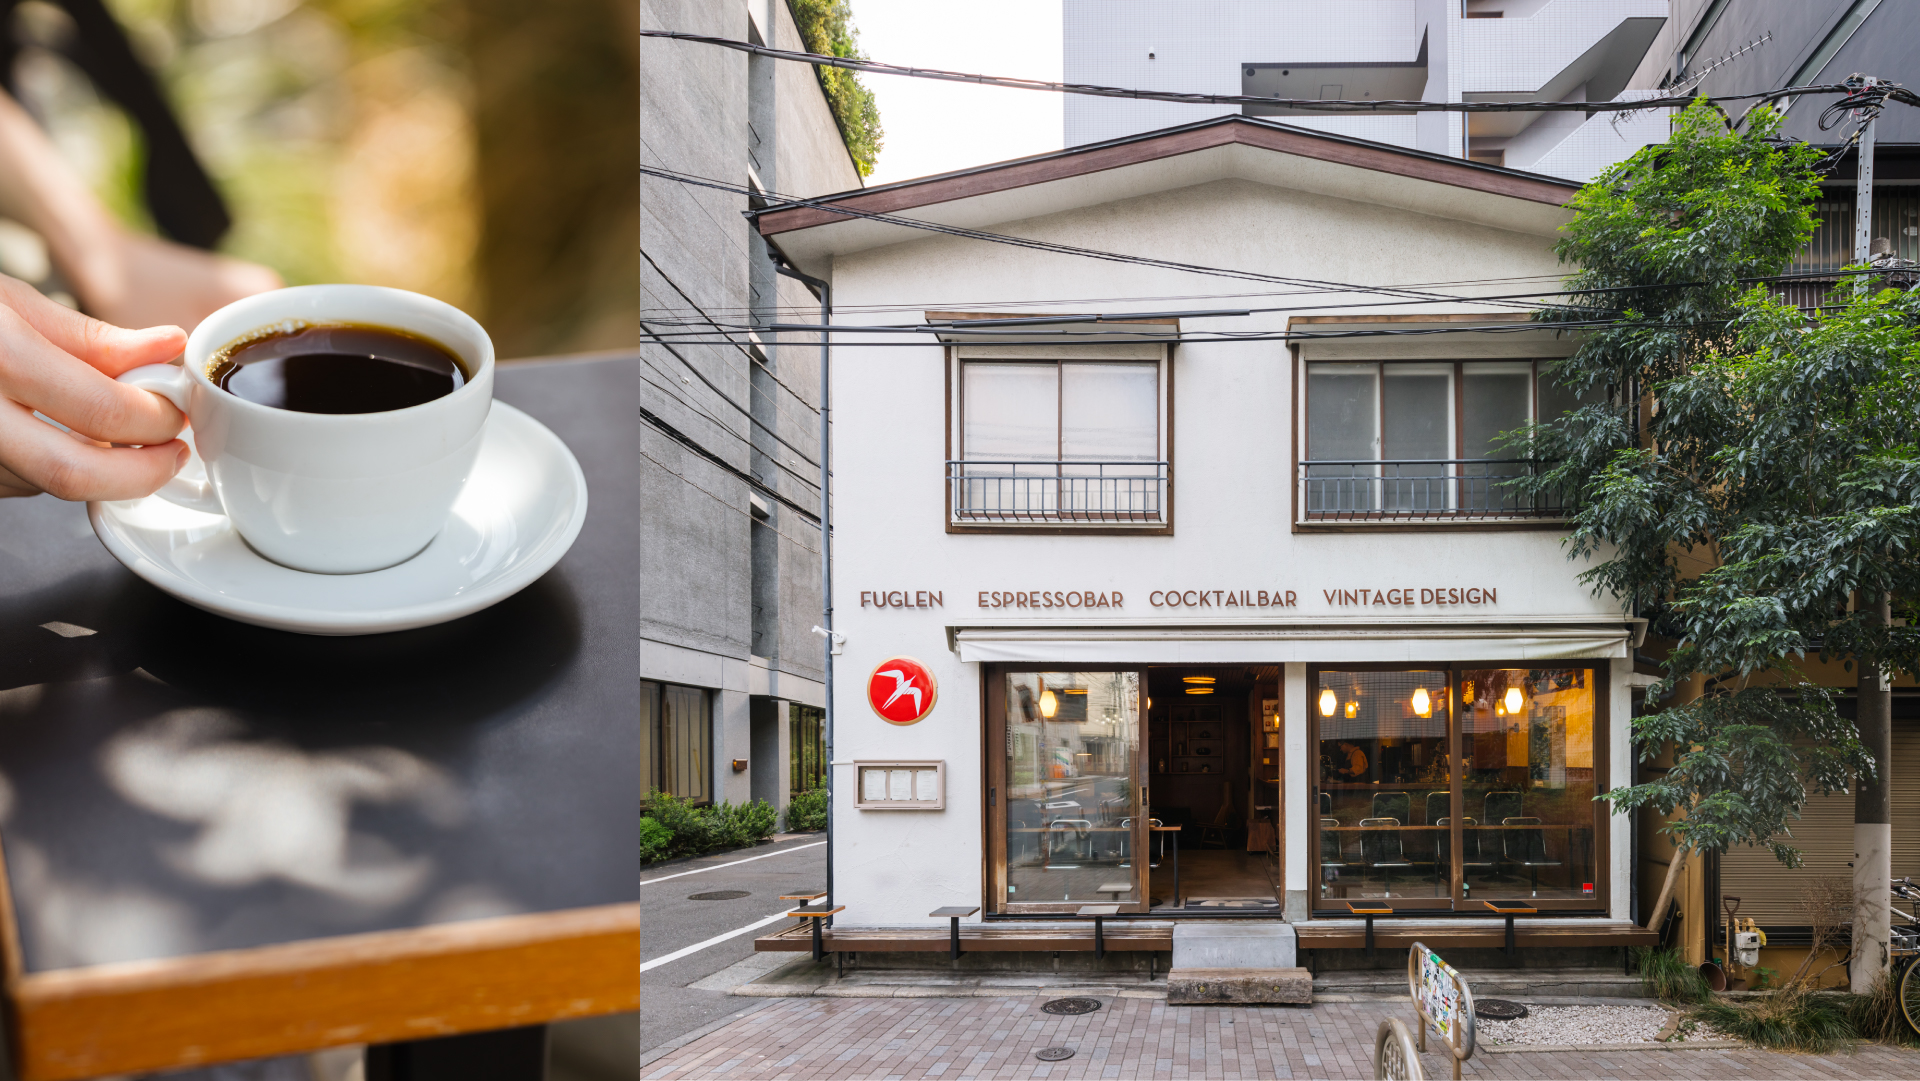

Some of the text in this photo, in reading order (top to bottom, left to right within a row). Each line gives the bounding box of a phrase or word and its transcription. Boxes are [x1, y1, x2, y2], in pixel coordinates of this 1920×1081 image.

[860, 587, 1497, 608] FUGLEN ESPRESSOBAR COCKTAILBAR VINTAGE DESIGN
